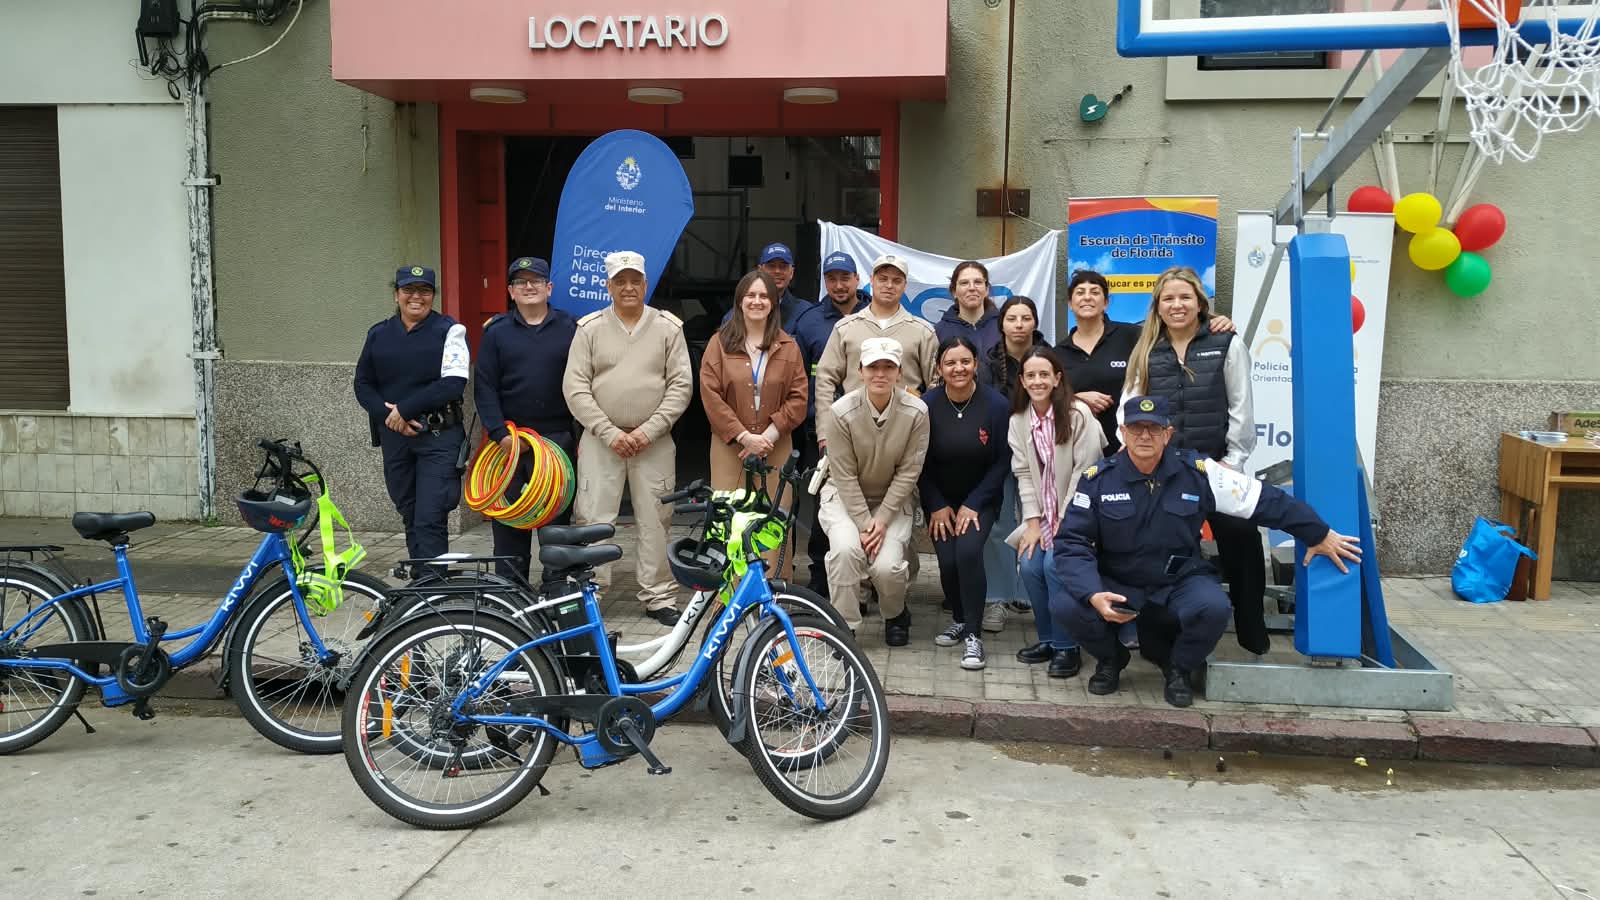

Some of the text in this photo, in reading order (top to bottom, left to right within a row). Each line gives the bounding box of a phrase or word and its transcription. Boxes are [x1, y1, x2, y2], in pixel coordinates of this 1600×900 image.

[528, 15, 729, 49] LOCATARIO
[618, 205, 646, 214] Interior
[1080, 233, 1205, 246] Escuela de Tránsito
[573, 245, 608, 259] Direc
[1111, 247, 1173, 258] de Florida
[572, 259, 607, 273] Nacio
[570, 273, 586, 285] de
[1133, 280, 1145, 288] es
[569, 286, 610, 301] Camin
[1101, 493, 1131, 502] POLICIA
[221, 561, 258, 612] KIWI
[703, 602, 741, 659] KIWI
